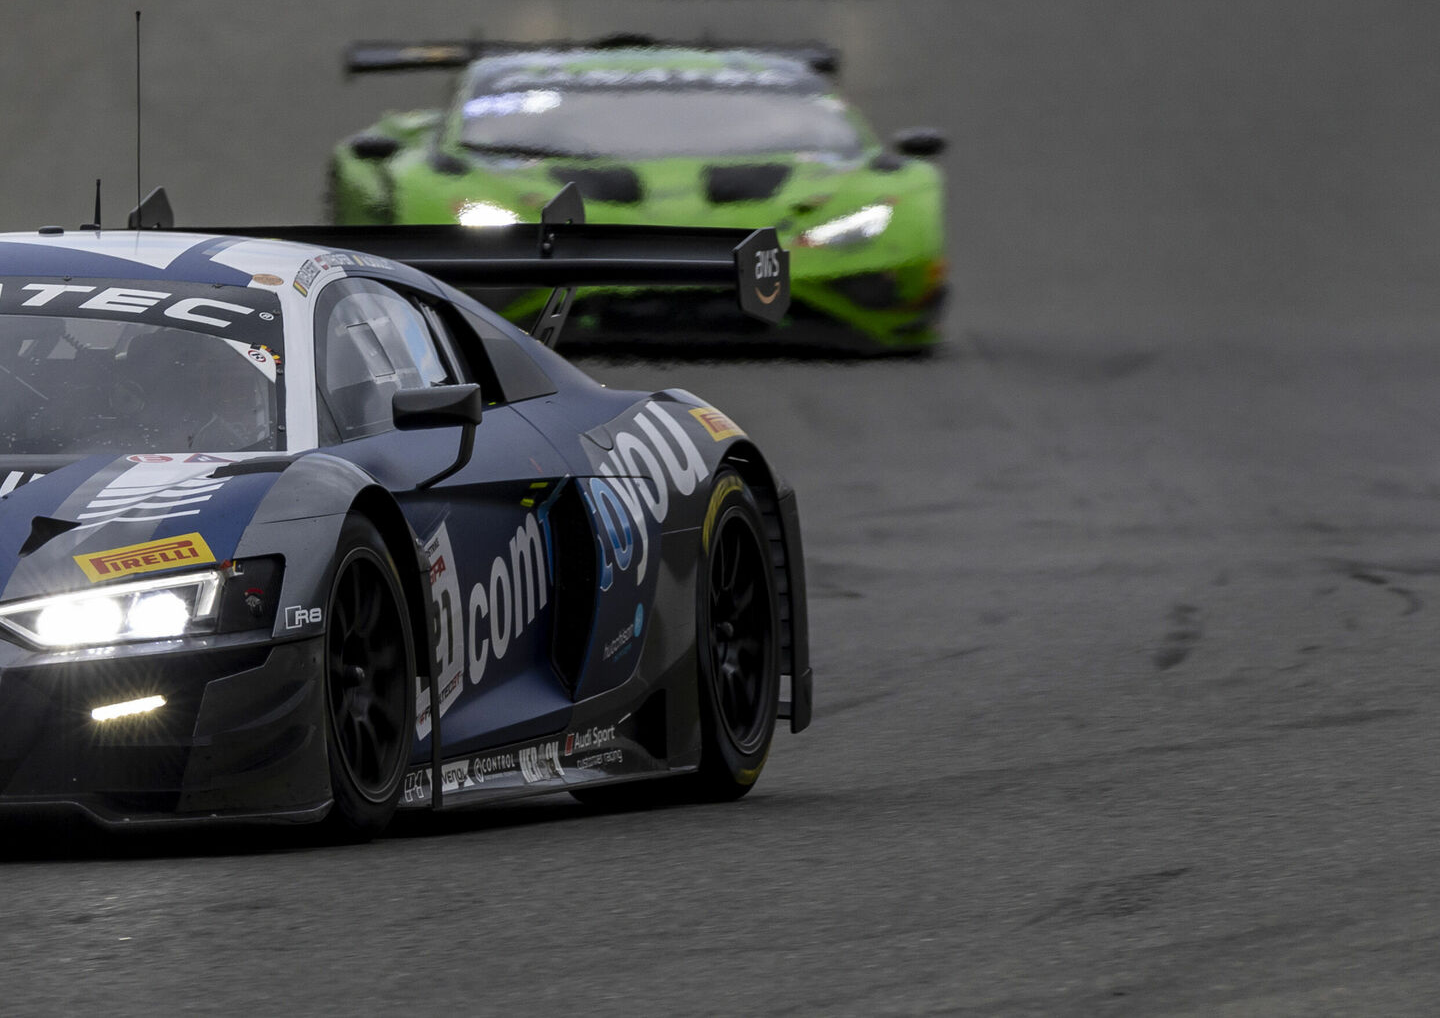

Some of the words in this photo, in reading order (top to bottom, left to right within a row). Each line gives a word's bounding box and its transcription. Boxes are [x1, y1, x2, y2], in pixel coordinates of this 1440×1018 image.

[755, 248, 780, 279] aws
[88, 539, 200, 575] PIRELLI
[574, 730, 592, 750] Audi
[593, 725, 616, 747] Sport
[482, 753, 515, 773] CONTROL
[576, 754, 603, 770] customer
[604, 748, 623, 765] racing
